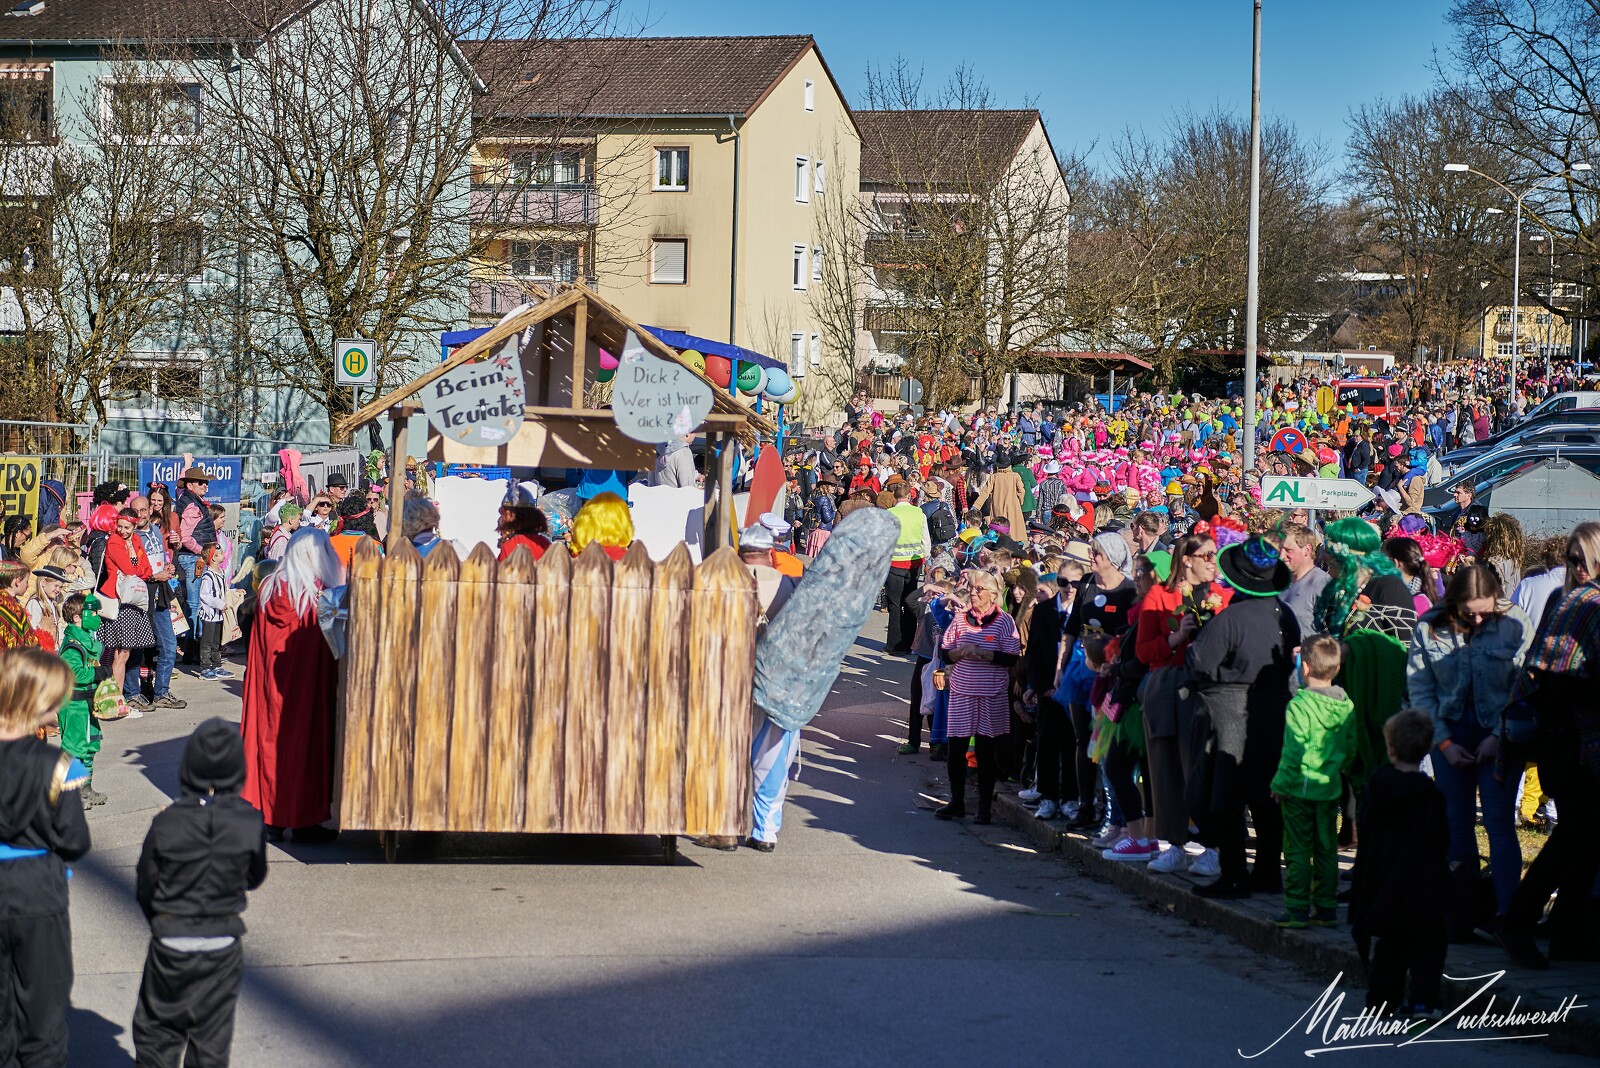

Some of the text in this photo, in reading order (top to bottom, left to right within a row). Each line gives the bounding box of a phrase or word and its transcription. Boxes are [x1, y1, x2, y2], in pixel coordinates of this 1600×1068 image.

[350, 354, 360, 371] H
[634, 366, 668, 384] Dick
[435, 371, 504, 399] Beim
[1347, 389, 1359, 399] 112
[620, 390, 702, 408] Wer ist hier
[436, 394, 526, 428] Teutates
[1265, 480, 1358, 503] ANL Parkplätze
